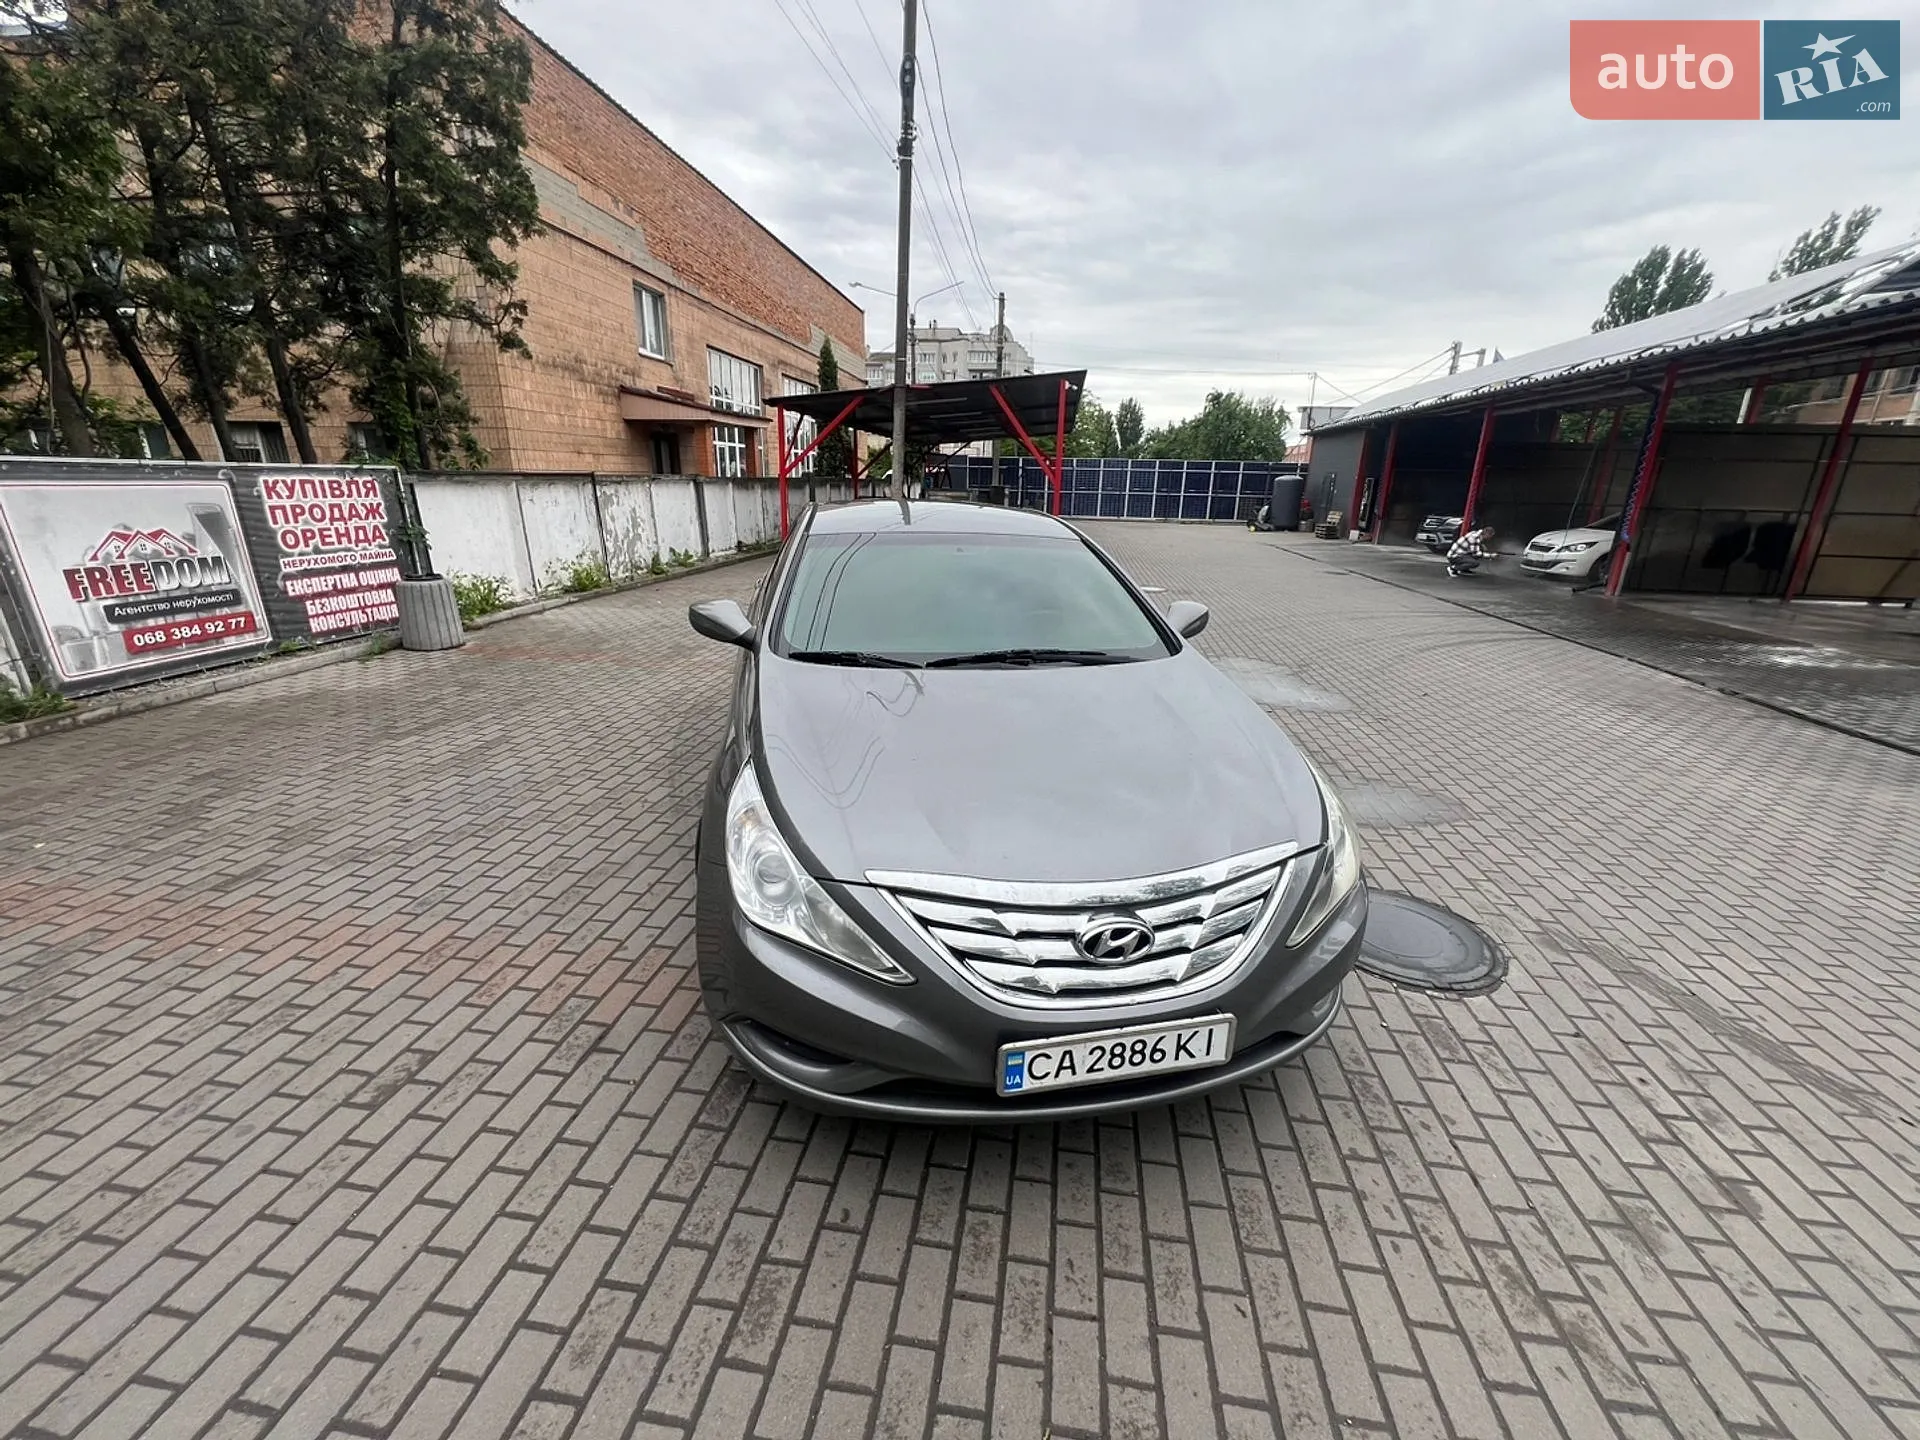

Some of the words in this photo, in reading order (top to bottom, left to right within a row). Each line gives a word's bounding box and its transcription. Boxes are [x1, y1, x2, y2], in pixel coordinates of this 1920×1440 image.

[262, 478, 379, 500] КУПІВЛЯ
[268, 503, 385, 525] ПРОДАЖ
[280, 525, 388, 549] ОРЕНДА
[282, 554, 358, 570] НЕРУХОМОГО
[359, 549, 394, 561] МАЙНА
[63, 555, 232, 600] FREEDOM
[285, 572, 359, 597] ЕКСПЕРТНА
[359, 567, 401, 586] ОЦІНКА
[114, 600, 170, 617] Агентство
[173, 593, 234, 608] нерухомості
[305, 588, 396, 616] БЕЗКОШТОВНА
[133, 631, 167, 646] 068
[170, 624, 202, 640] 384
[204, 621, 225, 634] 92
[228, 617, 246, 630] 77
[308, 604, 399, 633] КОНСУЛЬТАЦІЯ
[1027, 1050, 1077, 1080] CA
[1086, 1035, 1167, 1074] 2886
[1174, 1028, 1214, 1061] KI
[1006, 1075, 1021, 1086] UA
